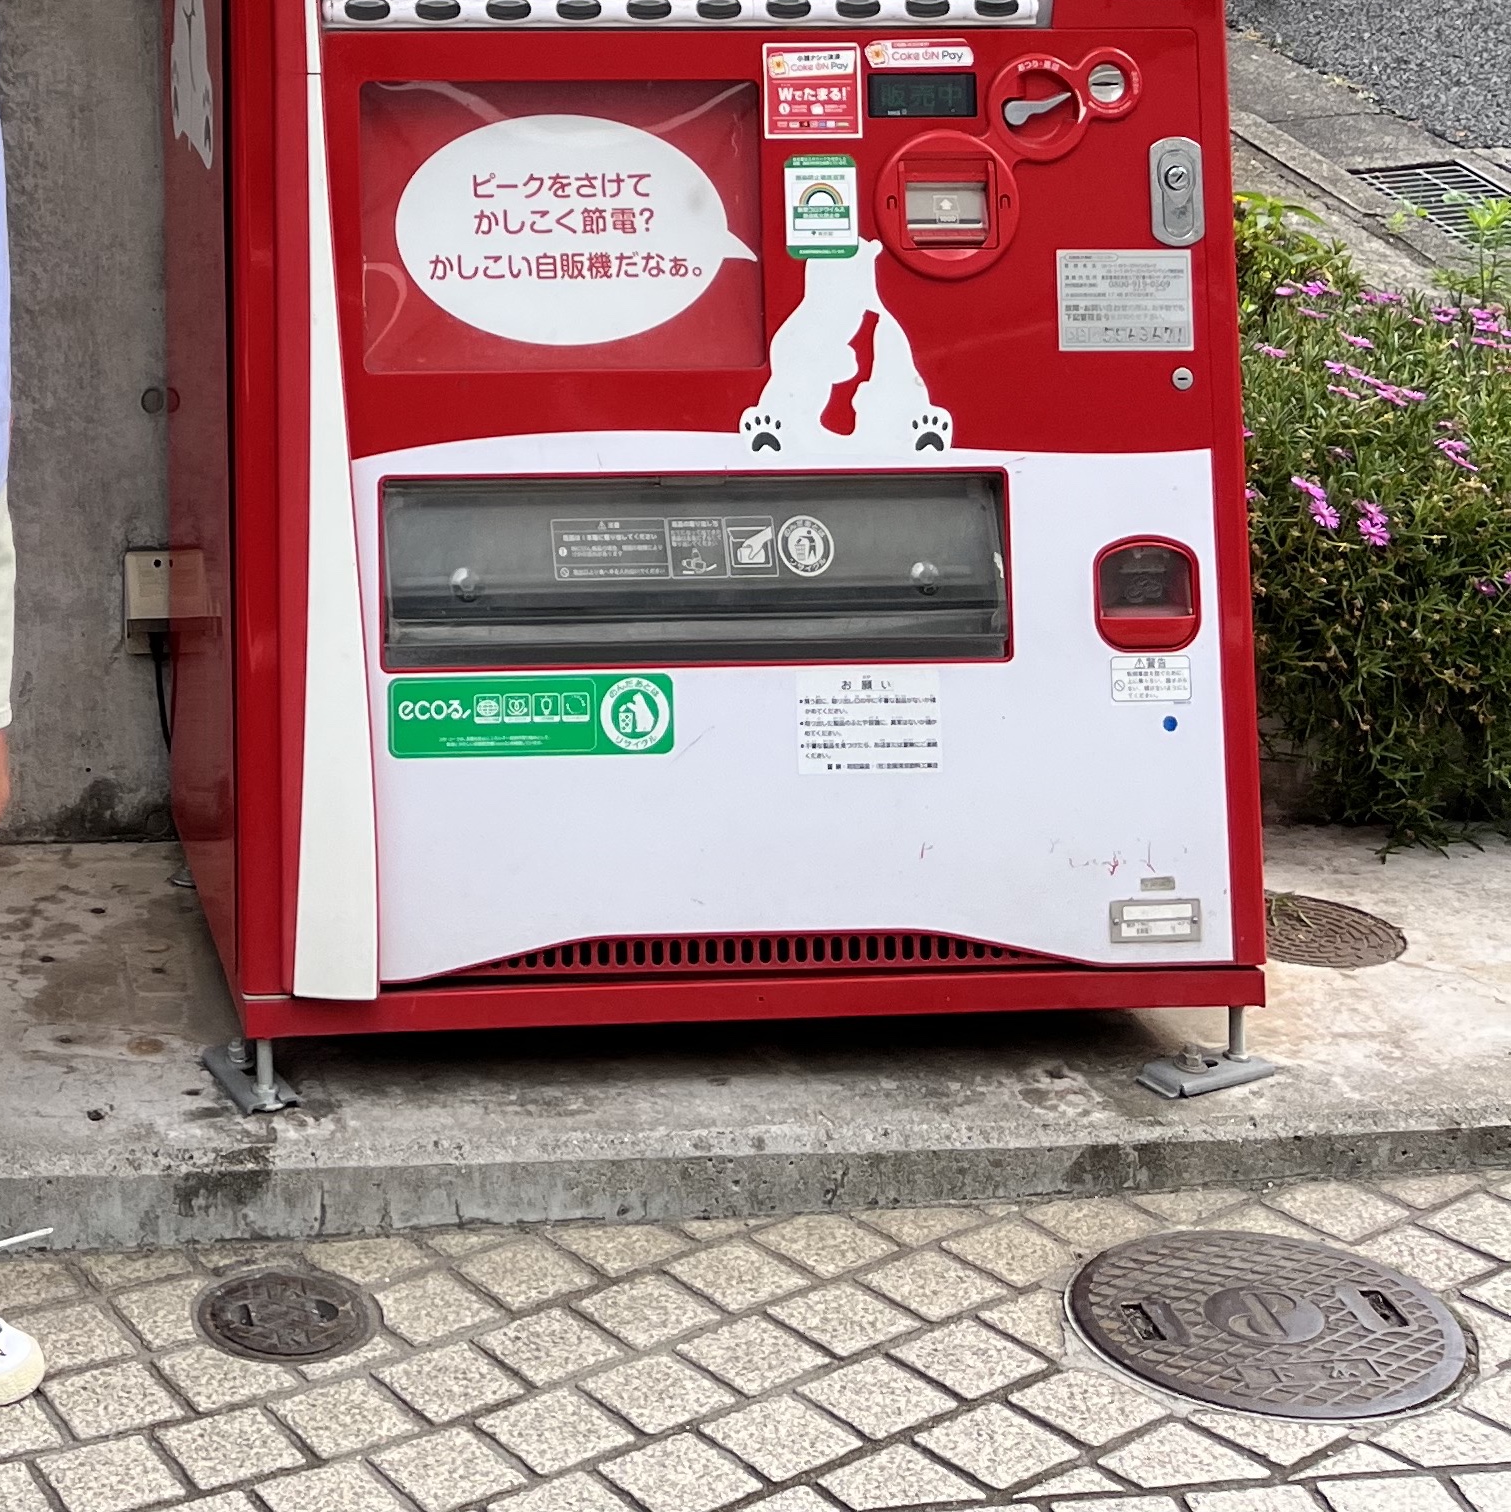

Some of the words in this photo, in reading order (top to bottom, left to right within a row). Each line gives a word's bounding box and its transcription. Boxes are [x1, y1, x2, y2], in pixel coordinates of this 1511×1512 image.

[892, 51, 920, 61] Coke
[922, 49, 939, 60] ON
[941, 51, 963, 62] Pay
[791, 63, 813, 71] Coke
[830, 62, 848, 71] Pay
[778, 87, 847, 101] Wでたまる!
[472, 172, 652, 199] ピークをさけて
[473, 207, 655, 235] かしこく節電?
[429, 251, 703, 280] かしこい自販機だなぁ。
[609, 680, 660, 699] のんだあとは
[841, 680, 891, 690] お願い
[614, 735, 658, 749] リサイクル
